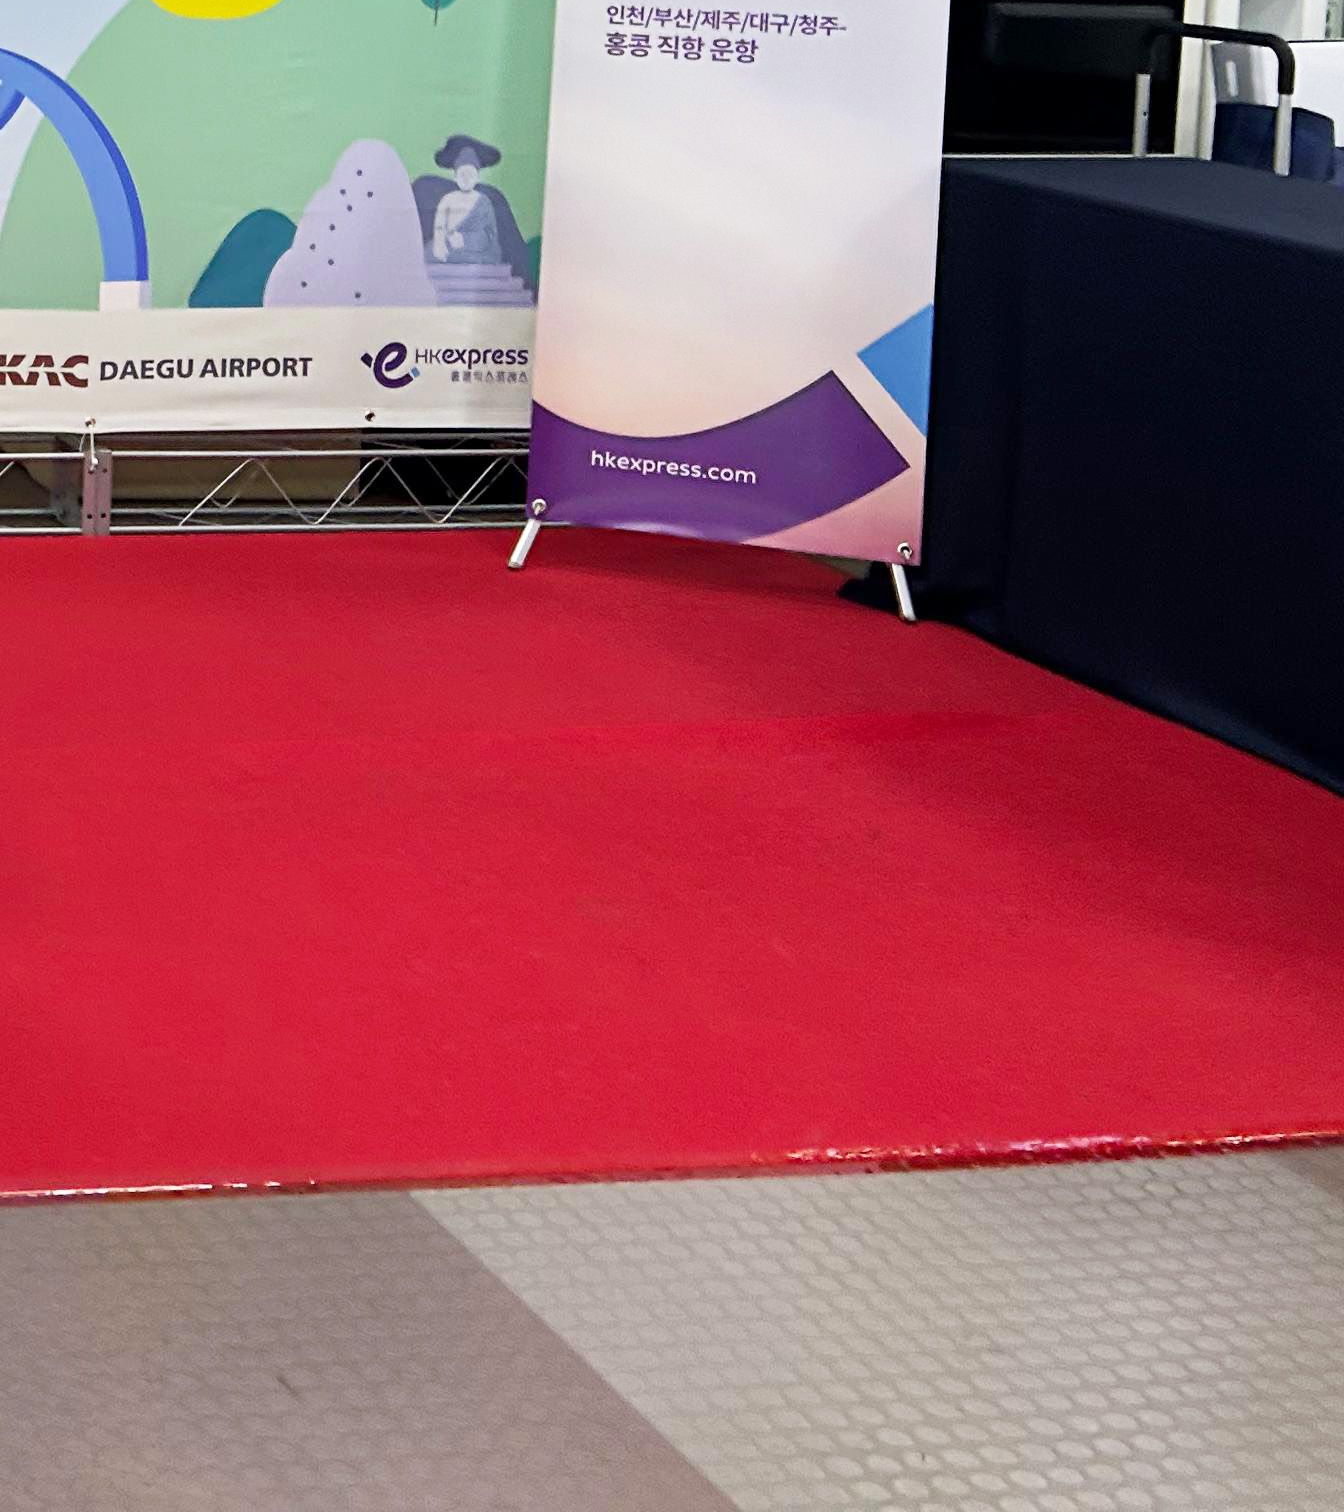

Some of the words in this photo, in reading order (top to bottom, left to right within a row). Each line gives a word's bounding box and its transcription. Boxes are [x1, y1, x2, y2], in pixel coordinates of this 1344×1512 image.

[605, 32, 652, 59] 홍콩
[657, 34, 705, 61] 직항
[710, 37, 759, 64] 운항
[100, 358, 194, 381] DAEGU
[199, 356, 313, 378] AIRPORT
[415, 349, 529, 370] HKexpress
[590, 449, 757, 485] hkexpress.com
